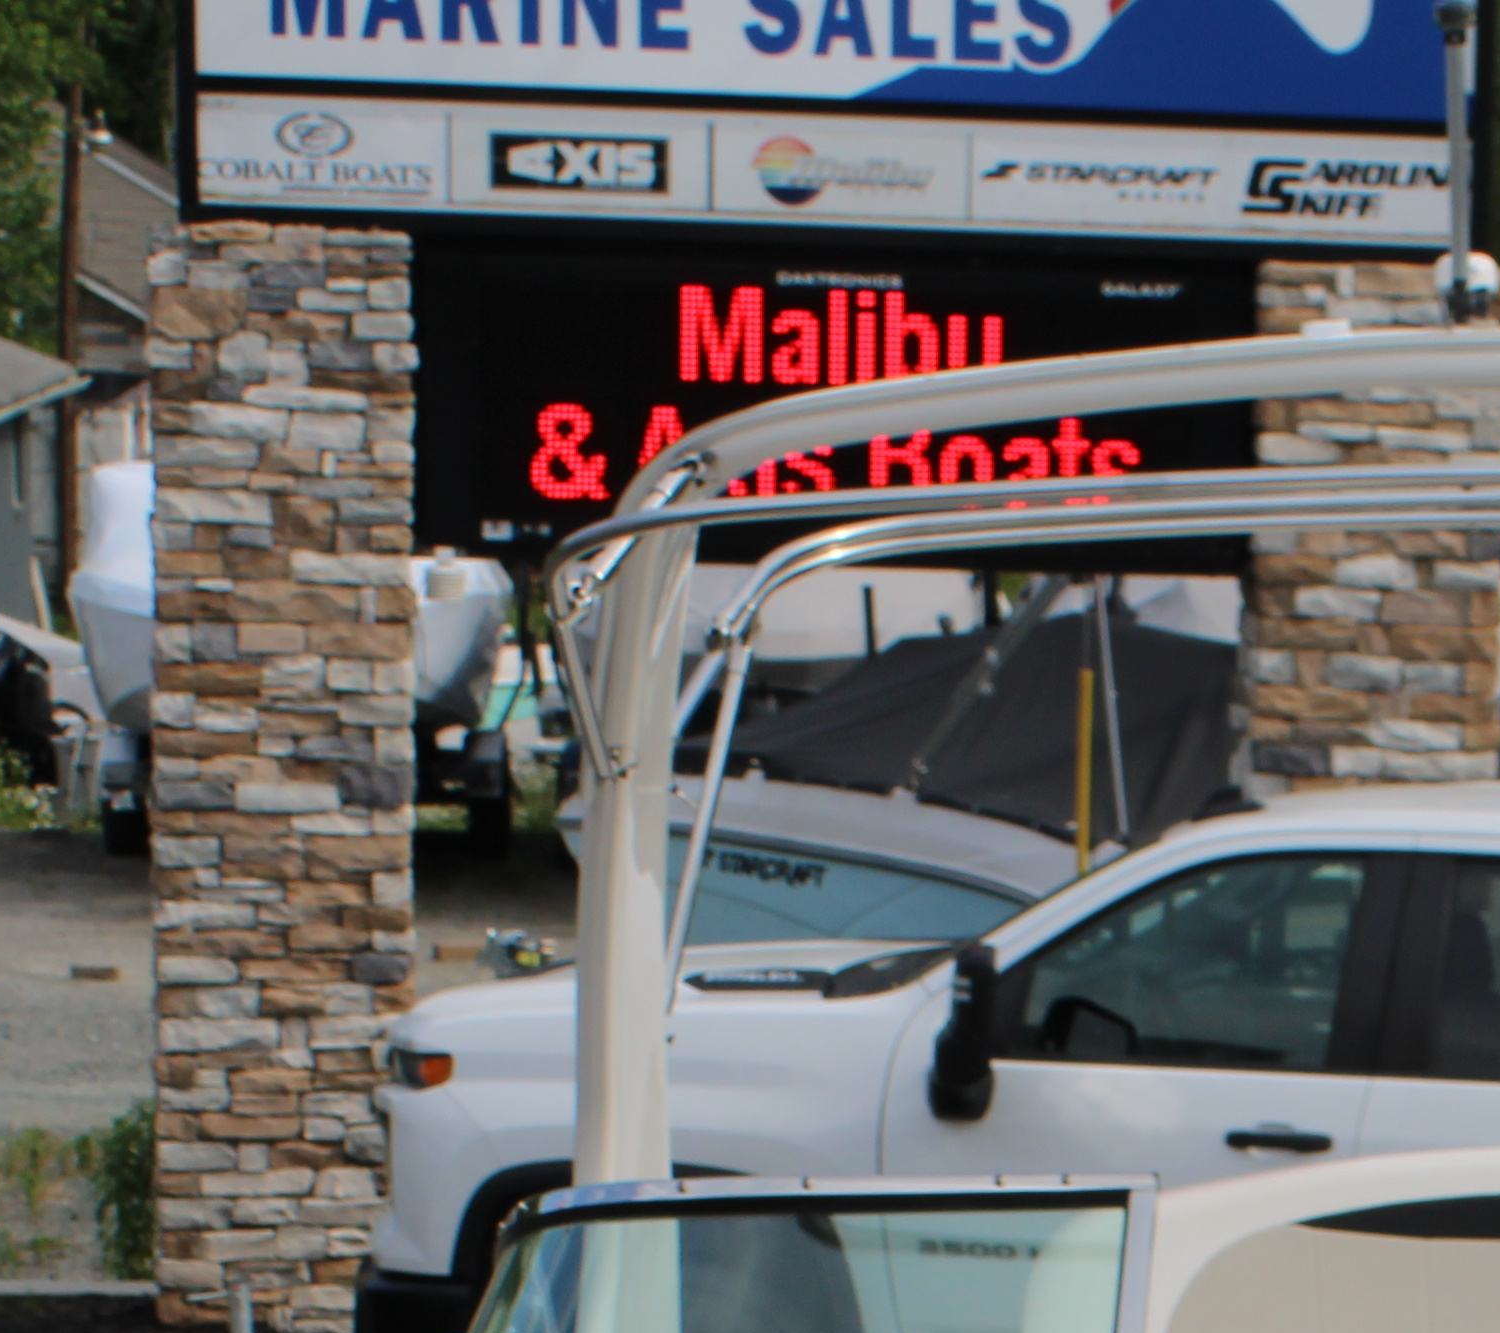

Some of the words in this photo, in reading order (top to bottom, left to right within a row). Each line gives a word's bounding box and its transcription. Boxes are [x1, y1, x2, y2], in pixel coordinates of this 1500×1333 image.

[744, 0, 1071, 65] SALES
[197, 157, 322, 184] COBALT
[333, 161, 432, 187] BOATS
[506, 140, 658, 187] AXIS
[1027, 163, 1219, 187] STARCRAFT
[1248, 157, 1452, 198] CAROLIN
[678, 284, 1003, 386] Malibu
[531, 403, 610, 500] &
